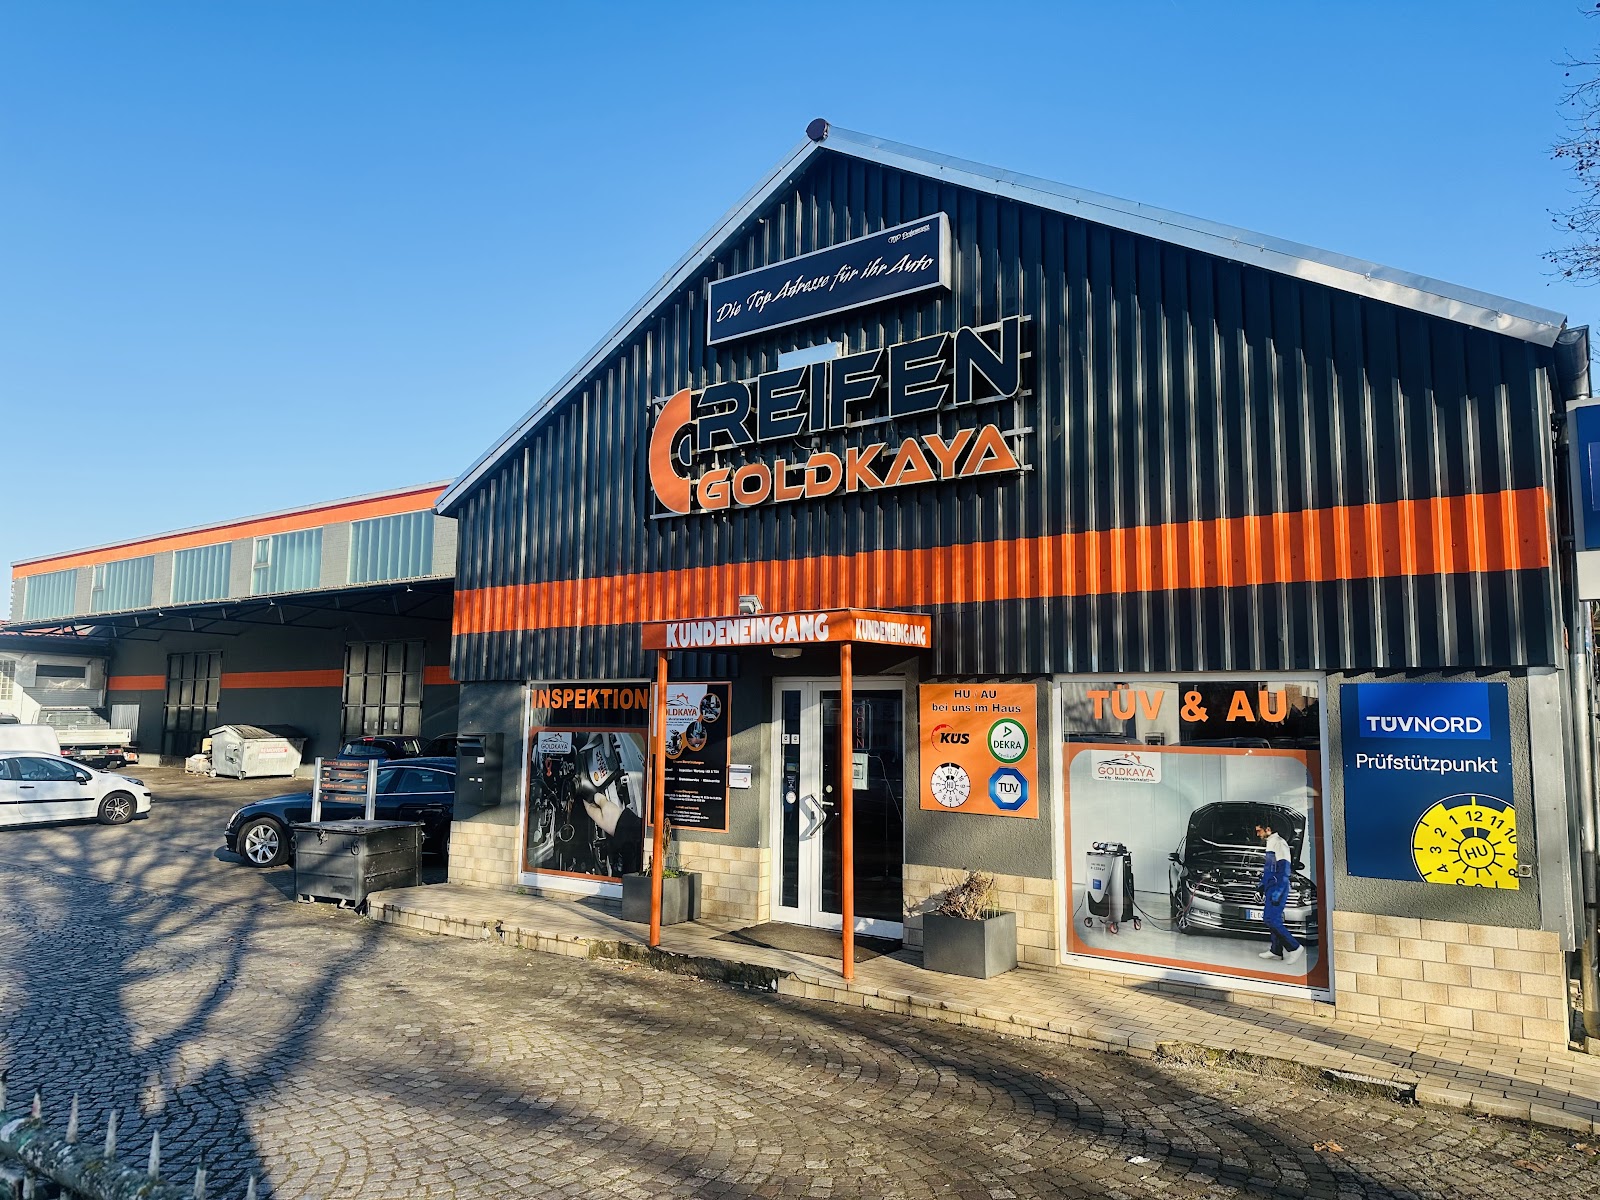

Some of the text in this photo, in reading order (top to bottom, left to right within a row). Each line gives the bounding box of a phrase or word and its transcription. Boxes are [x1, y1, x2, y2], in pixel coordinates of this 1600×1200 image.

[716, 253, 934, 323] Die Top Adresse für ihr Auto
[697, 314, 1021, 453] REIFEN
[697, 424, 1020, 510] GOLDKAYA
[666, 613, 829, 648] KUNDENEINGANG
[855, 618, 926, 646] KUNDENEINGANG
[532, 688, 648, 709] INSPEKTION
[954, 690, 971, 698] HU
[981, 690, 997, 699] AU
[932, 703, 948, 711] bei
[975, 704, 988, 712] im
[992, 704, 1021, 713] Haus
[1086, 684, 1288, 723] TÜV & AU
[1366, 716, 1482, 733] TÜVNORD
[940, 732, 970, 744] KÜS
[993, 740, 1022, 749] DEKRA
[1356, 753, 1498, 775] Prüfstützpunkt
[1098, 766, 1154, 777] GOLDKAYA
[946, 781, 954, 789] HU
[998, 783, 1019, 793] TÜV
[1449, 815, 1458, 825] 1
[1466, 810, 1482, 822] 12
[1490, 816, 1505, 829] 11
[1434, 827, 1447, 837] 2
[1430, 846, 1442, 854] 3
[1465, 844, 1488, 860] HU
[1437, 863, 1448, 873] 4
